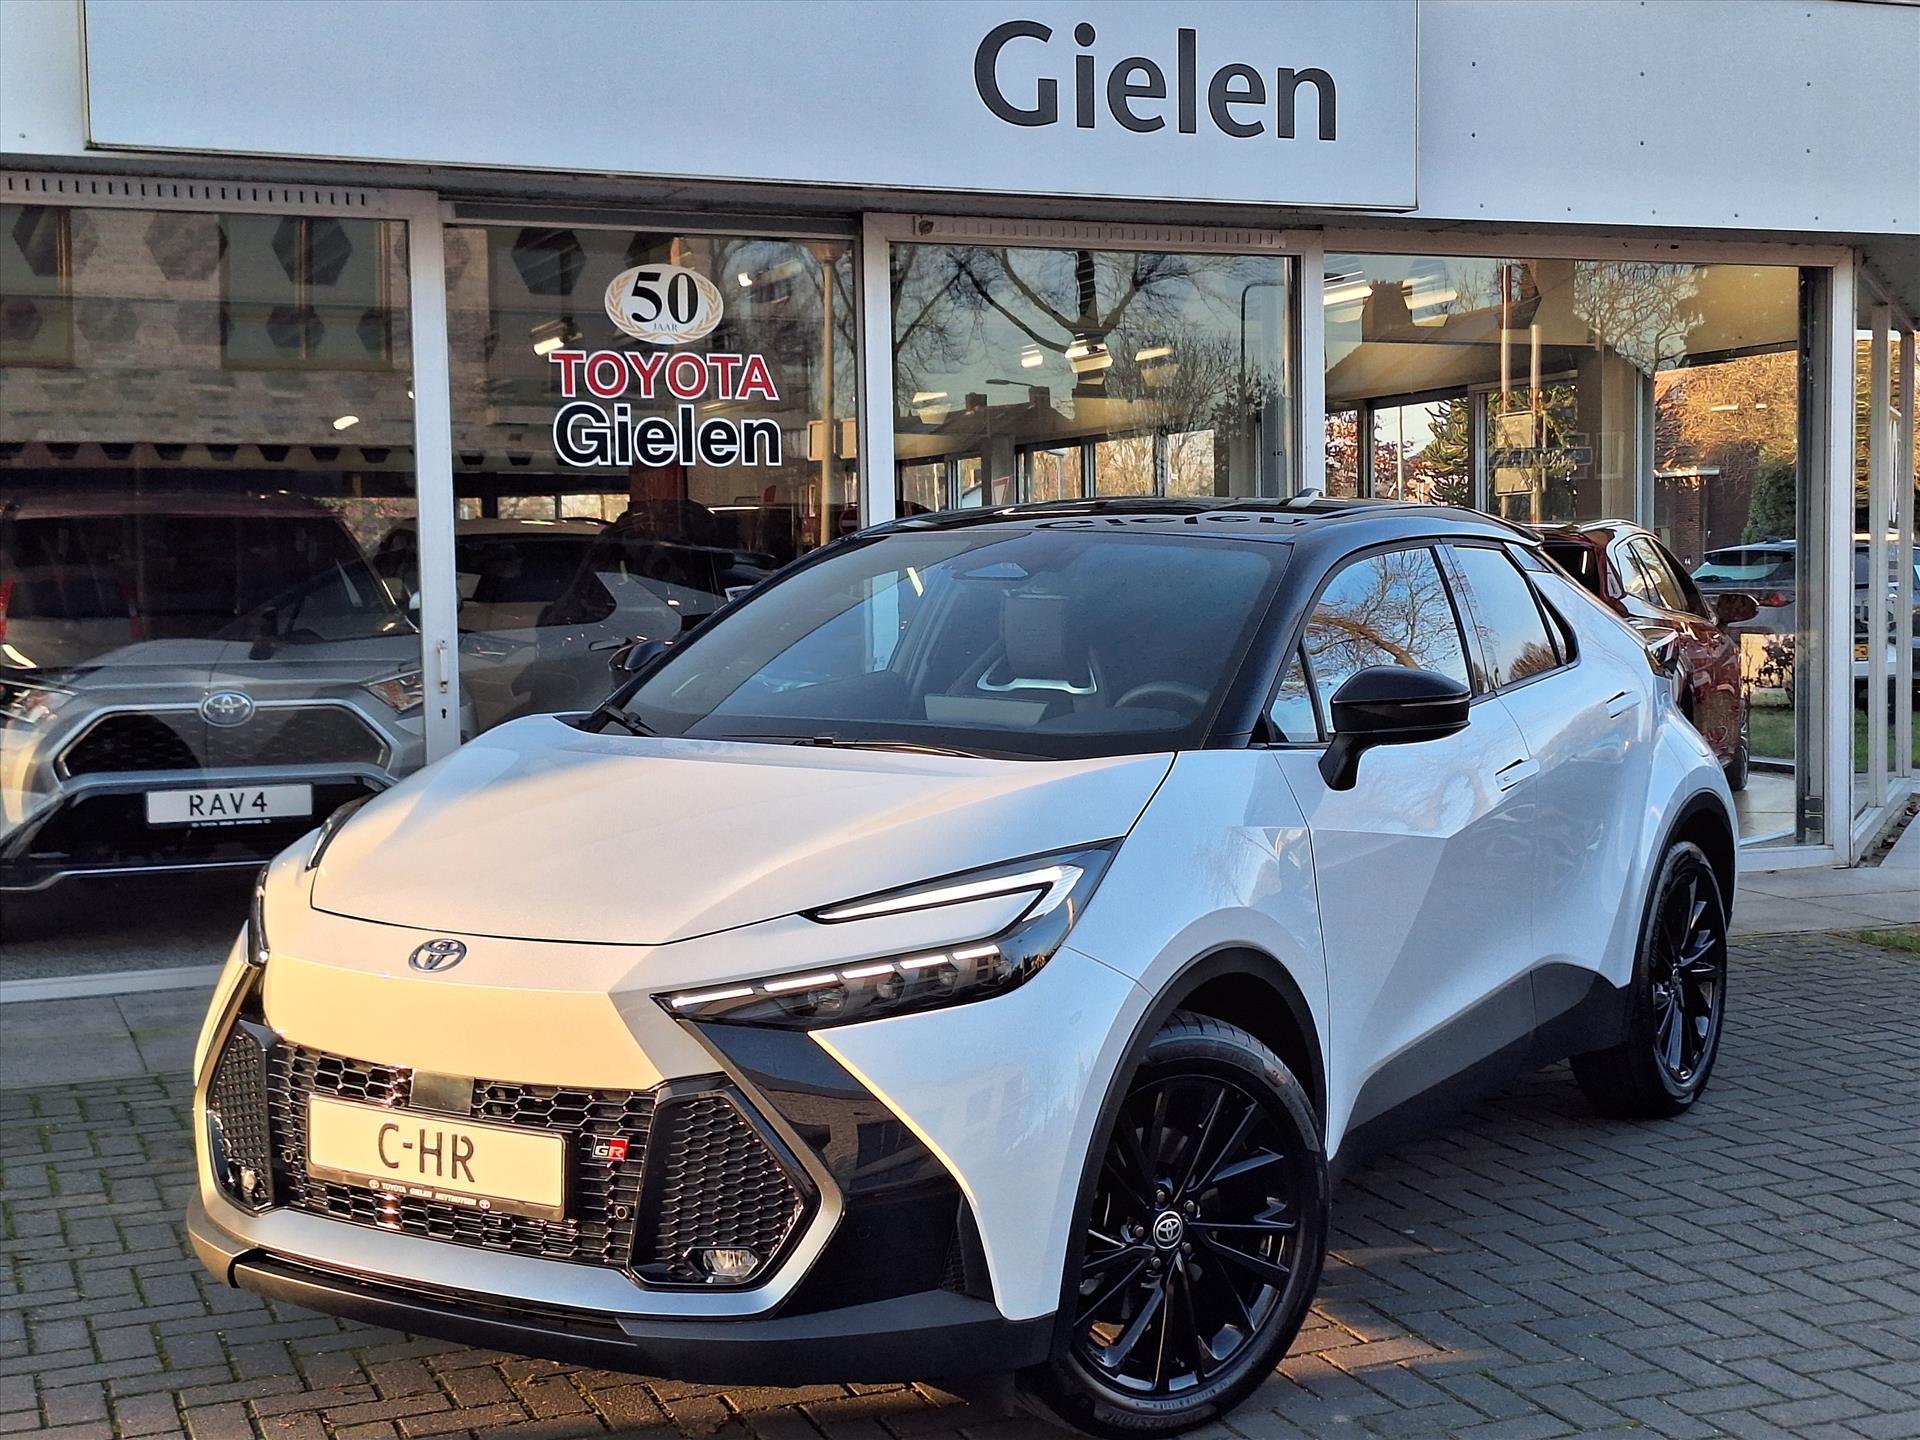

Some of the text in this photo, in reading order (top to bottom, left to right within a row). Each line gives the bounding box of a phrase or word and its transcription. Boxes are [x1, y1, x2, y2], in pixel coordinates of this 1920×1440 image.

[974, 20, 1336, 141] Gielen
[631, 271, 699, 325] 50
[652, 322, 678, 332] JAAR
[550, 350, 780, 400] TOYOTA
[553, 401, 782, 467] Gielen
[378, 1123, 475, 1183] C-HR
[594, 1145, 625, 1158] GR
[381, 1182, 407, 1193] TOYOTA
